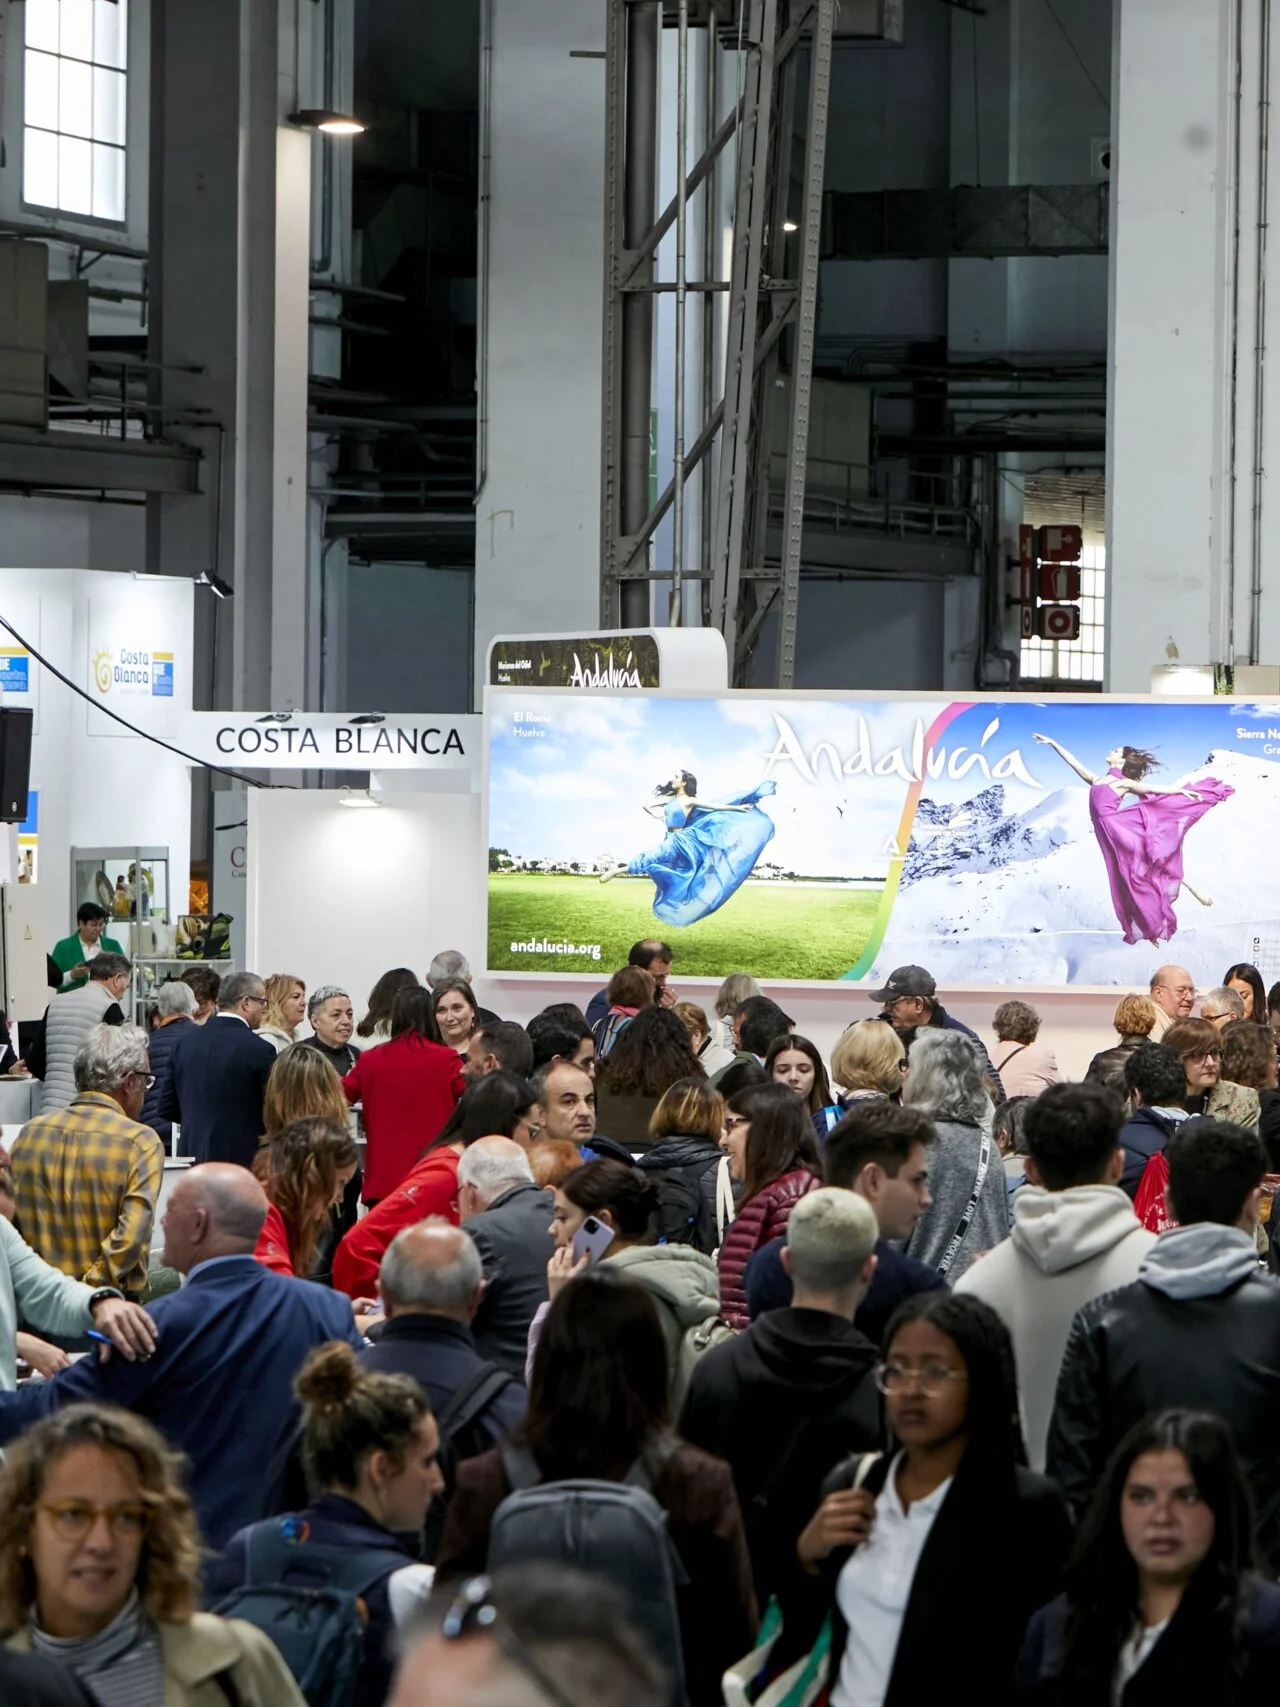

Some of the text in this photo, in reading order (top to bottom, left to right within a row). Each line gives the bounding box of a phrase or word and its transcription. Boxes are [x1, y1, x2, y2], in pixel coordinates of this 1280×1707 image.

[121, 649, 149, 665] Costa
[114, 666, 149, 684] Blanca
[570, 651, 642, 688] Andalucía
[514, 711, 552, 723] El Rocío
[215, 727, 465, 755] COSTA BLANCA
[513, 726, 545, 738] Huelva
[1236, 727, 1265, 739] Sierra
[759, 712, 1046, 790] Andalucía
[510, 937, 602, 960] andalucia.org
[963, 1200, 978, 1222] LOVE
